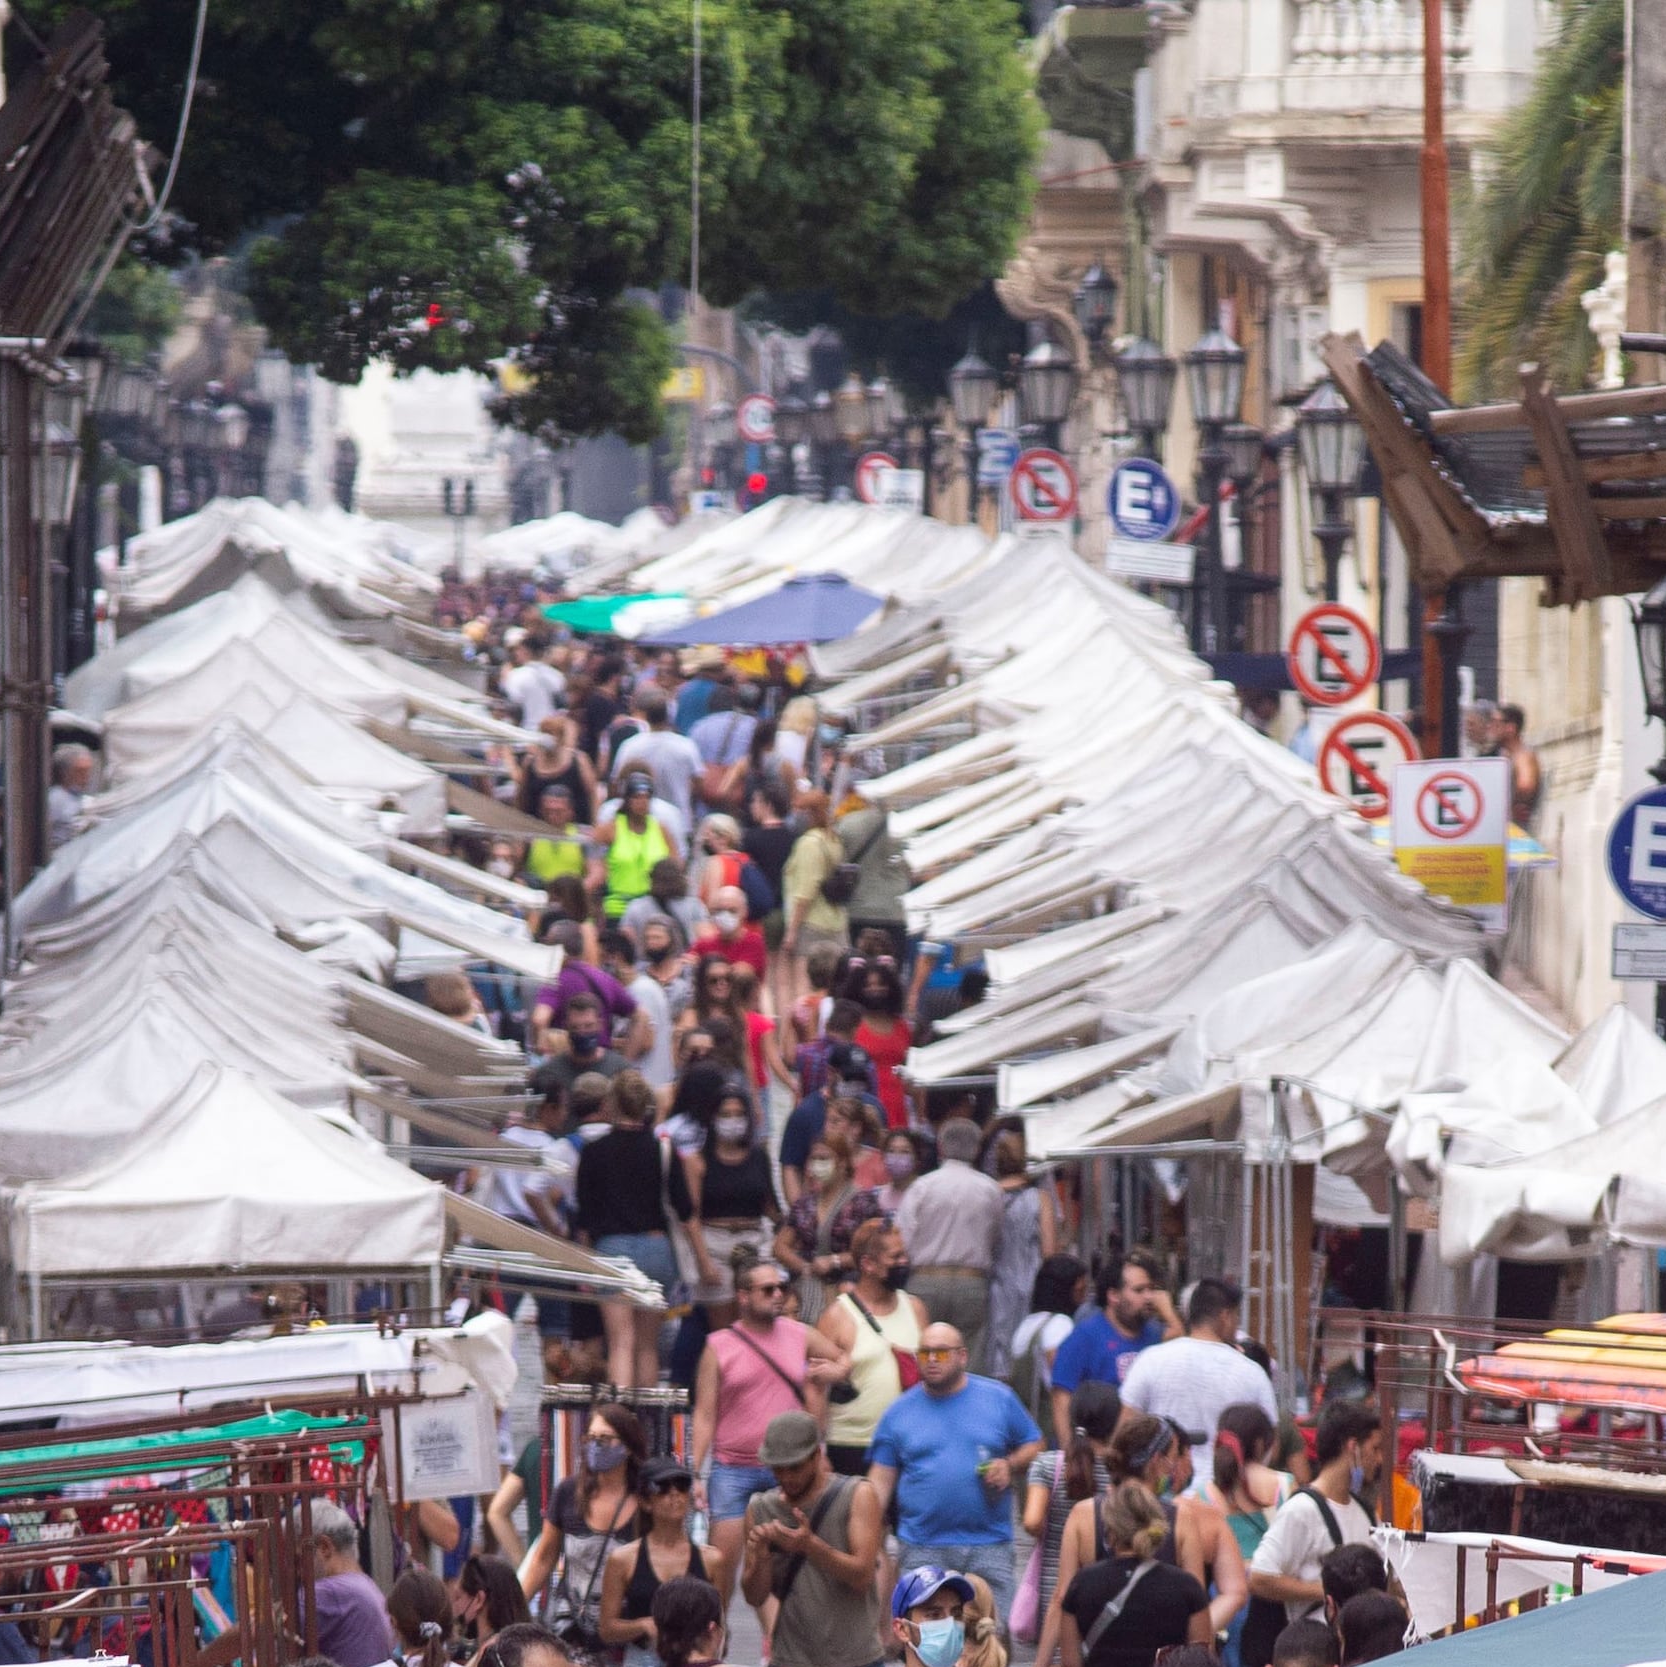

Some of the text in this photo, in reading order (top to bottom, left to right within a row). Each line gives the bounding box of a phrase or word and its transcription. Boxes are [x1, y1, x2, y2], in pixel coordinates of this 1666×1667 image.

[1117, 469, 1152, 521] E
[1316, 625, 1350, 682] E
[1348, 736, 1385, 796] E
[1438, 784, 1463, 825] E
